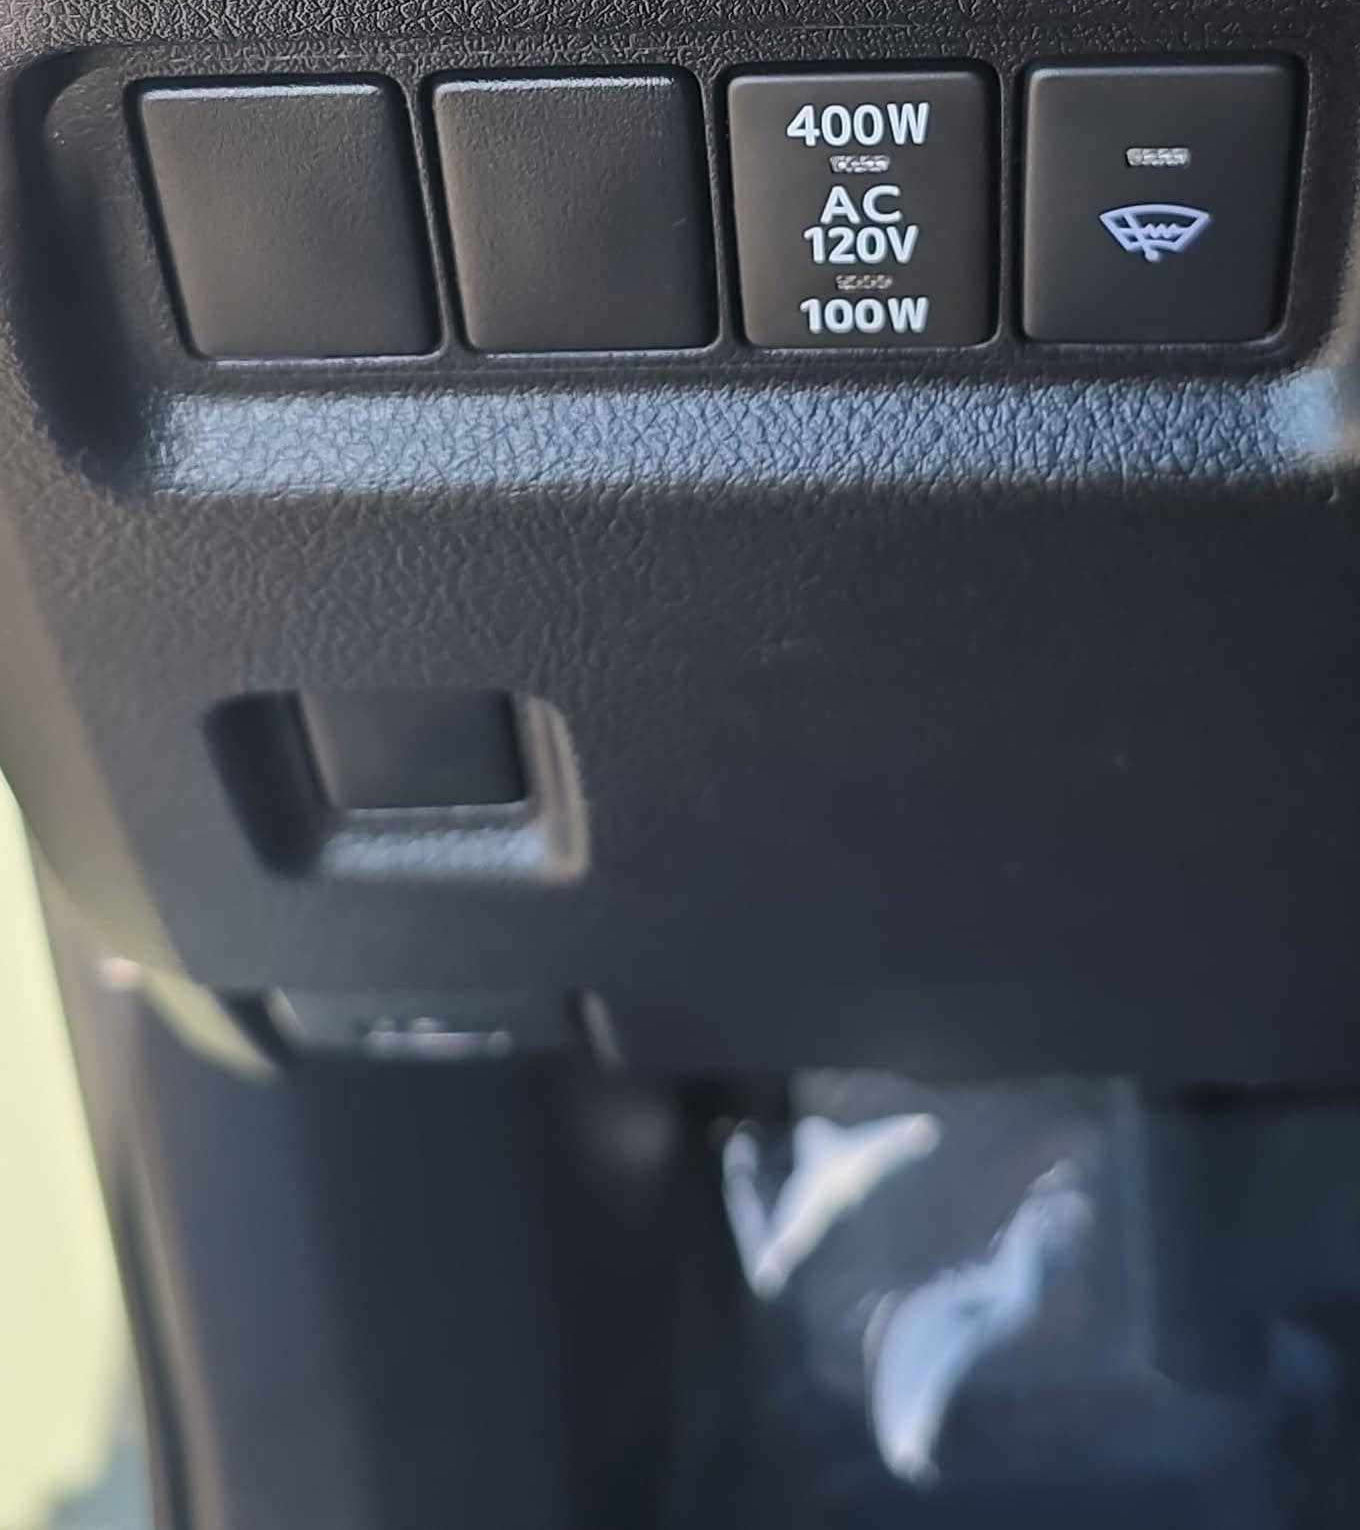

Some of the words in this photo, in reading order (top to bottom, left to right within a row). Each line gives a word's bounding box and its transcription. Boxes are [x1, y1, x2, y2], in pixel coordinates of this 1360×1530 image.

[786, 102, 929, 146] 400W
[820, 185, 902, 224] AC
[803, 224, 919, 264] 120V
[799, 297, 929, 334] 100W
